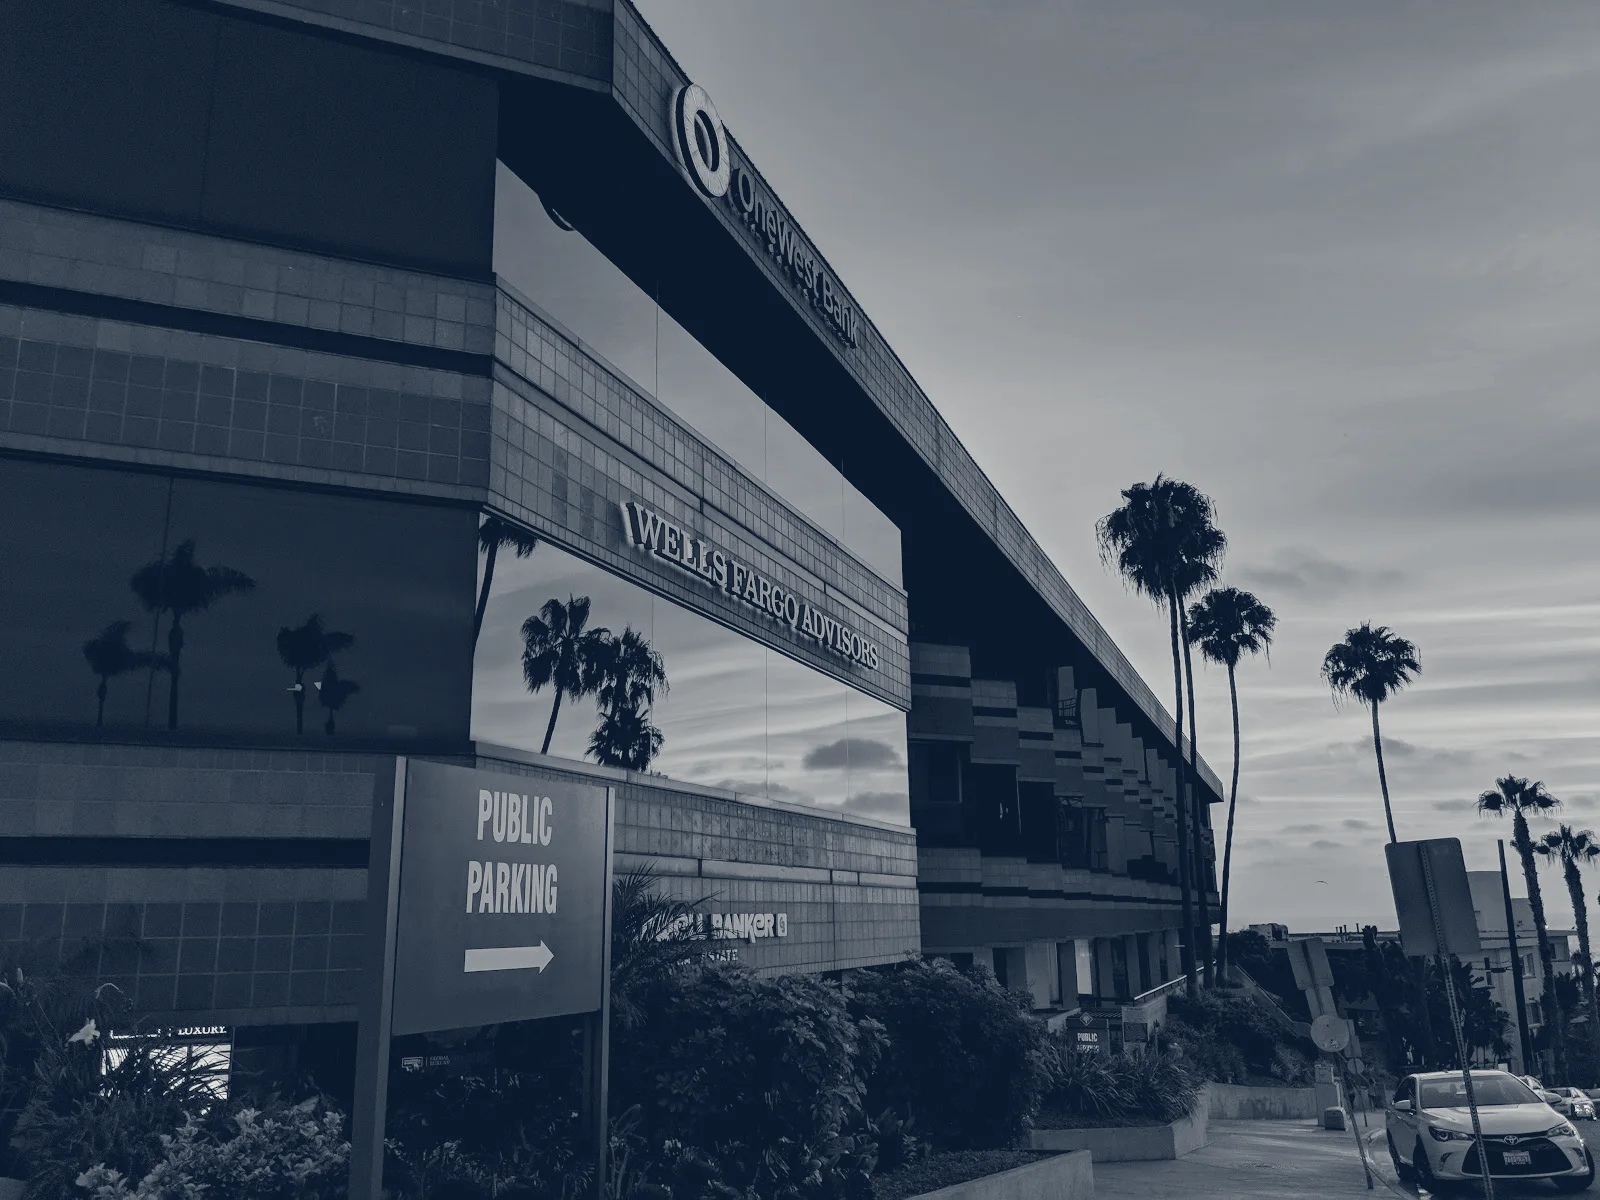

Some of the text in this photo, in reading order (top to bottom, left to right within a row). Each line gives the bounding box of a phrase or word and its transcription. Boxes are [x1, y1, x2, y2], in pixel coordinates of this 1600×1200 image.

[733, 168, 859, 349] OneWest Bank
[625, 501, 879, 671] WELLS FARGO ADVISORS
[477, 789, 553, 847] PUBLIC
[466, 860, 558, 915] PARKING
[178, 1025, 227, 1036] LUXURY
[1077, 1032, 1098, 1042] PUBLIC
